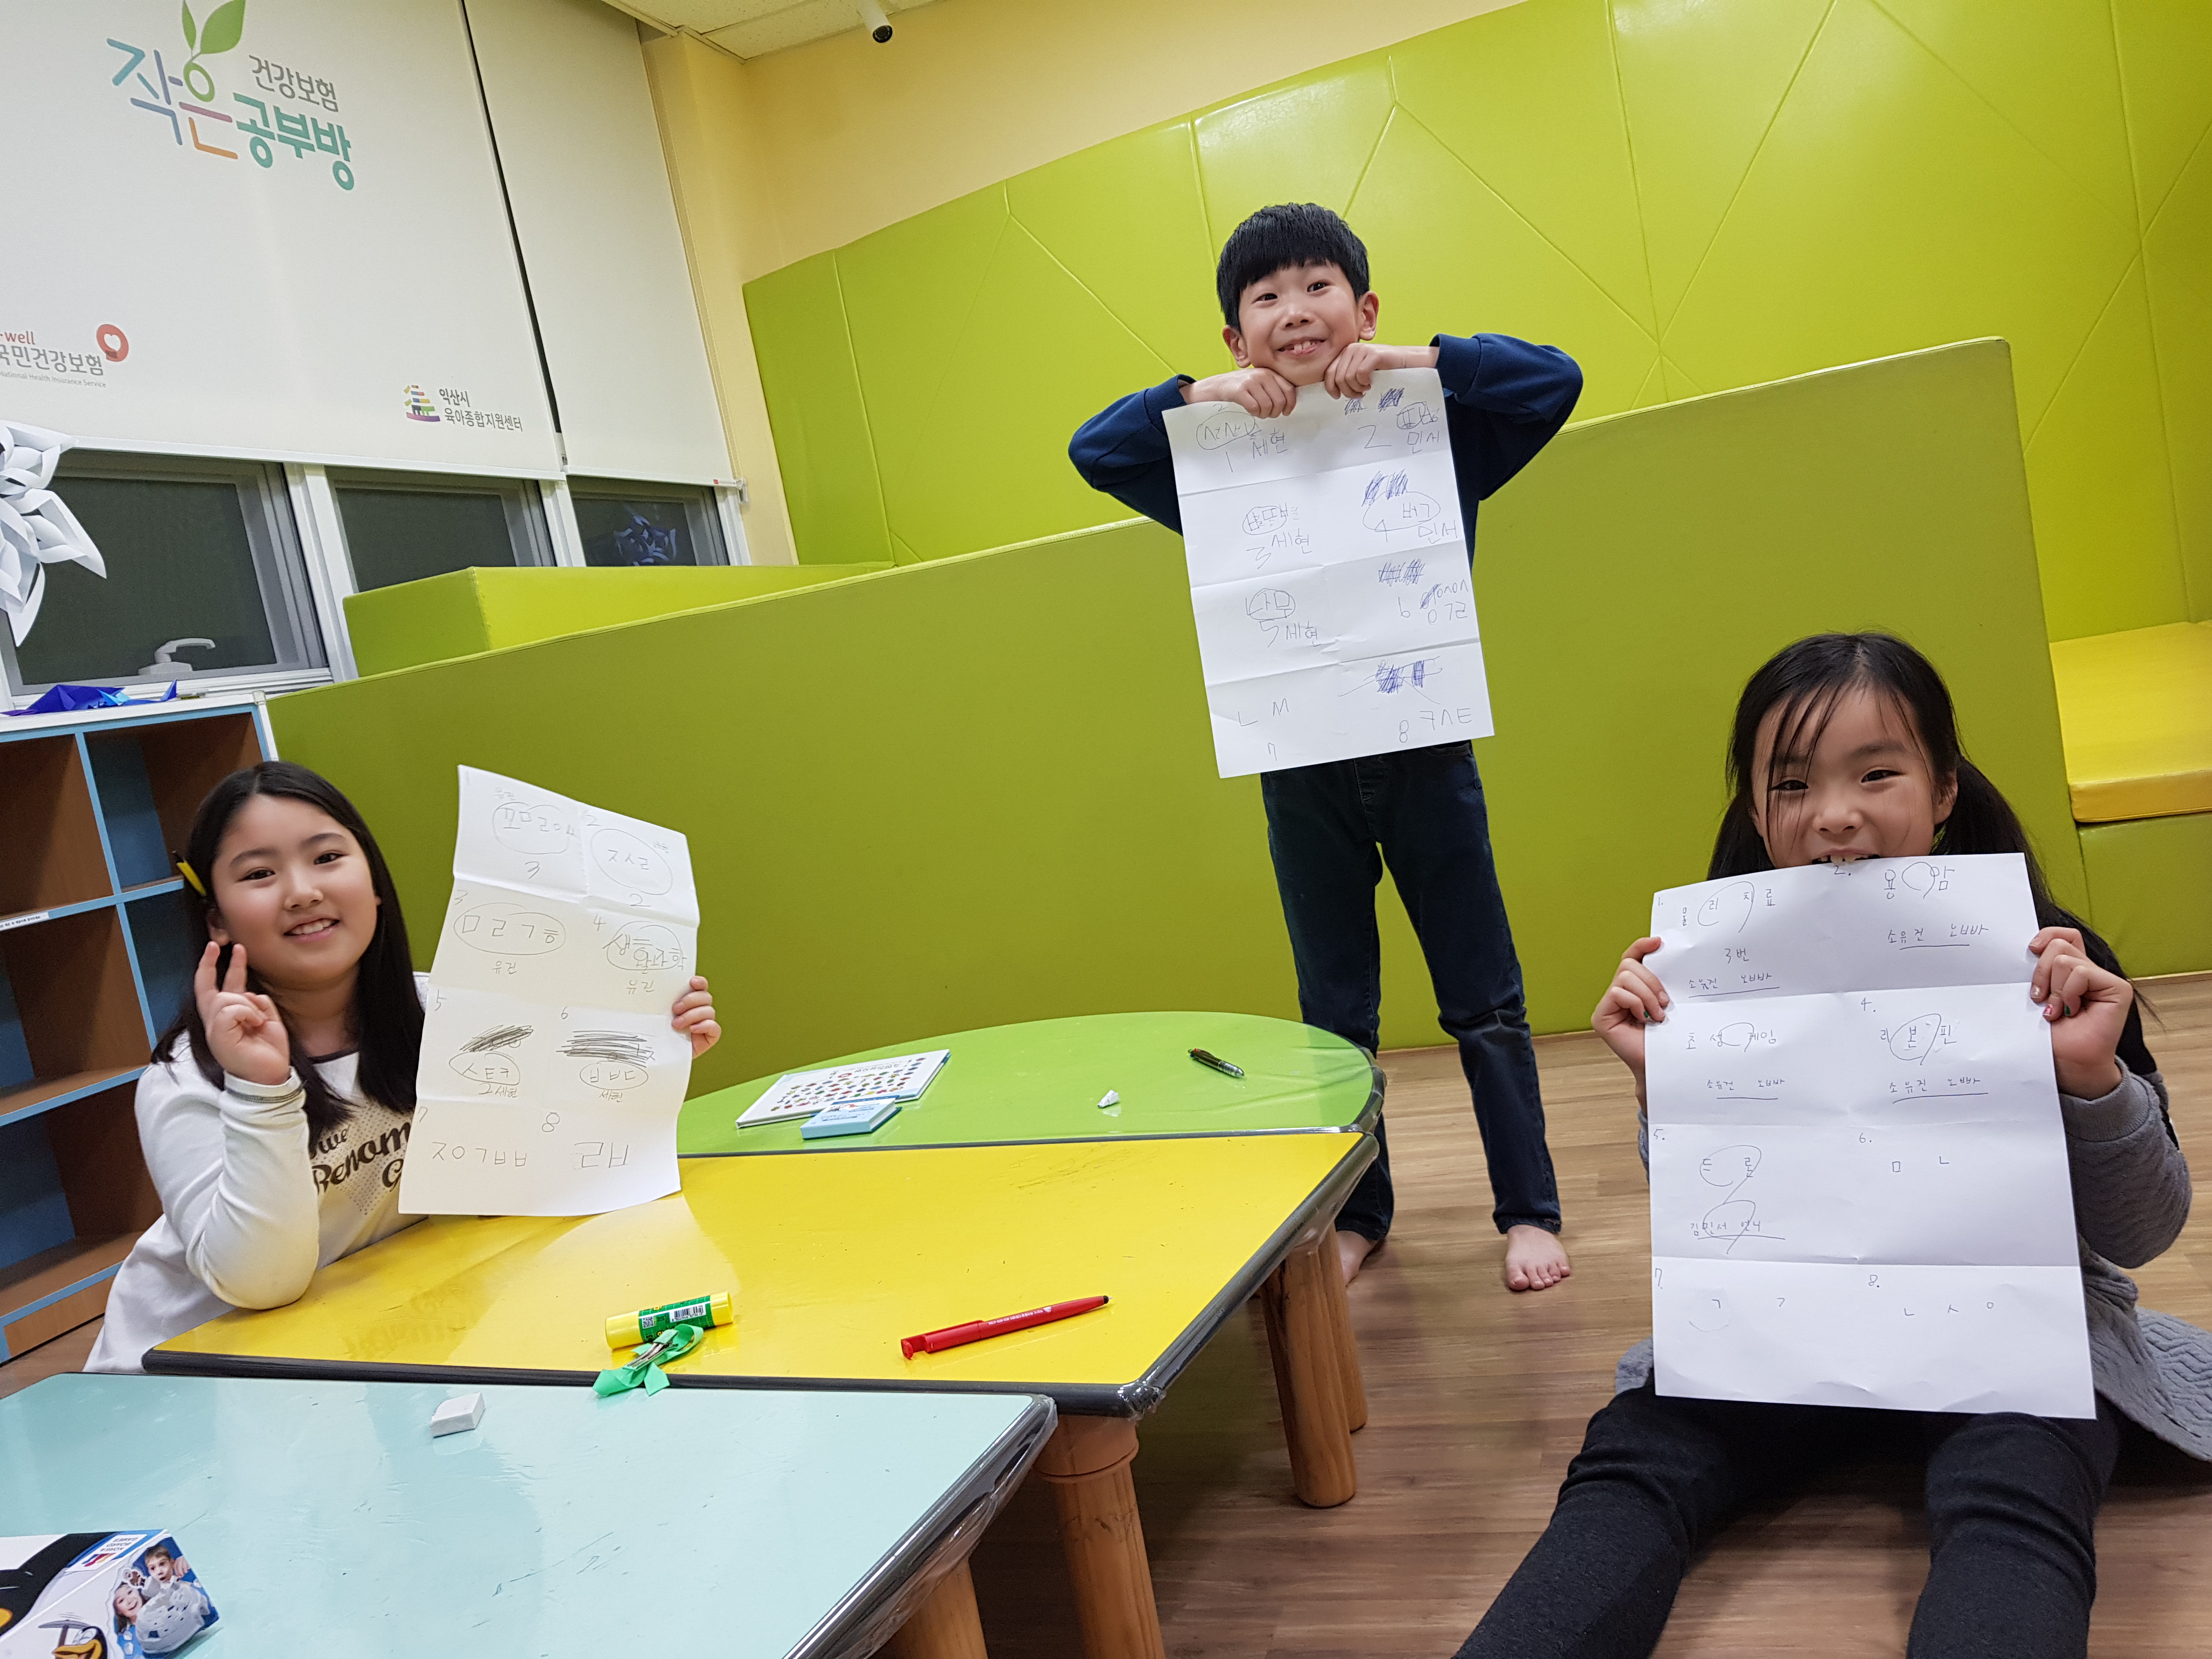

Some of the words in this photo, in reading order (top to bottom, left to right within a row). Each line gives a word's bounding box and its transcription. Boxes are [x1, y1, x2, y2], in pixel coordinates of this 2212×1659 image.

[249, 55, 340, 112] 건강보험
[106, 38, 238, 160] 작은
[233, 92, 354, 191] 공부방
[29, 374, 50, 382] Health
[52, 377, 82, 385] Insurance
[83, 380, 106, 388] Service
[439, 388, 470, 407] 익산시
[444, 408, 523, 432] 육아종합지원센터
[1252, 427, 1288, 460] 세현
[1358, 425, 1392, 449] 2
[1407, 430, 1440, 454] 민서
[1271, 528, 1312, 554] 세현
[1418, 520, 1458, 545] 민서
[1286, 620, 1322, 647] 세현
[1399, 720, 1409, 743] 8
[629, 893, 652, 907] 2
[593, 913, 607, 932] 4
[561, 1006, 569, 1020] 6
[541, 1111, 561, 1132] 8
